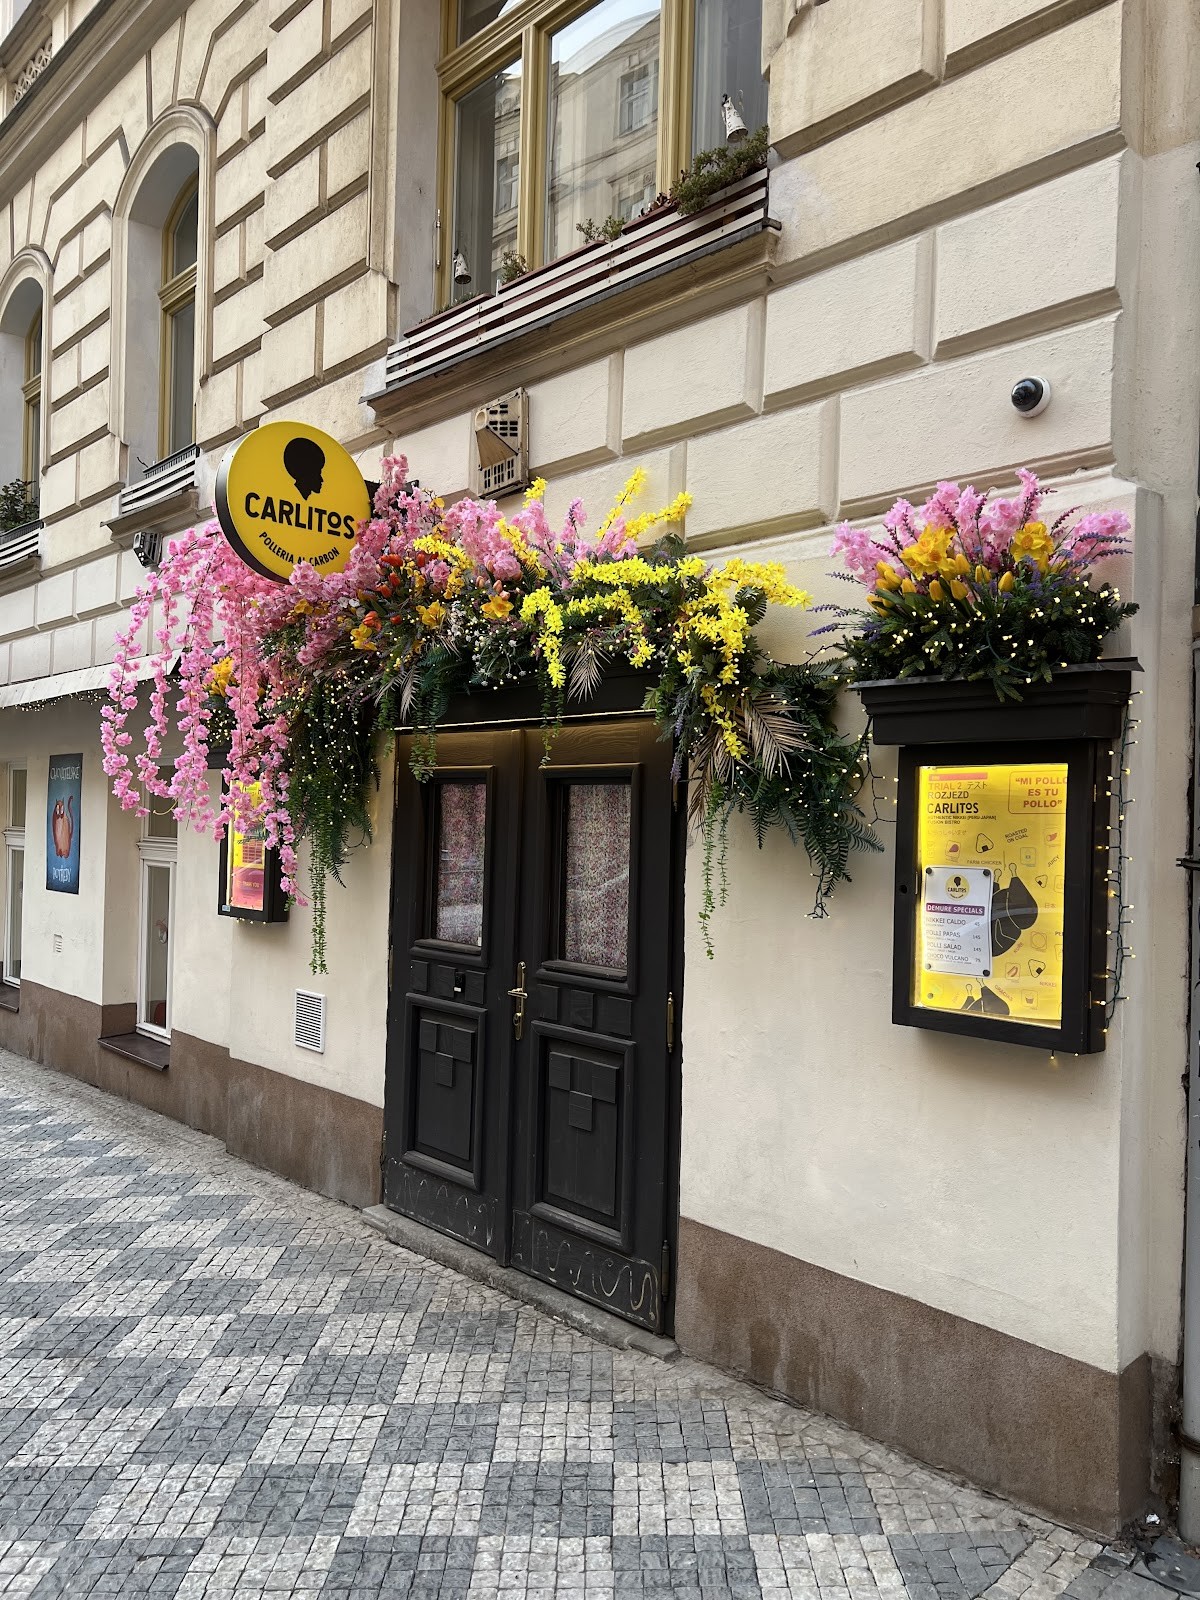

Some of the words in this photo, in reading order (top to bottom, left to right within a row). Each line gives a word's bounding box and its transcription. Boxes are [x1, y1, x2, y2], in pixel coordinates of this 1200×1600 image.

[245, 492, 355, 539] CARLITOS
[259, 532, 294, 564] POLLERIA
[309, 547, 340, 567] CARBON
[928, 782, 955, 790] TRIAL
[957, 782, 962, 790] 2
[967, 781, 988, 790] テスト
[928, 791, 970, 800] ROZJEZD
[1028, 788, 1041, 797] ES
[1045, 788, 1059, 797] TU
[928, 802, 979, 814] CARLITOS
[927, 904, 952, 913] DEMURE
[953, 906, 983, 915] SPECIALS
[946, 918, 966, 926] CALDO
[943, 943, 962, 951] SALAD
